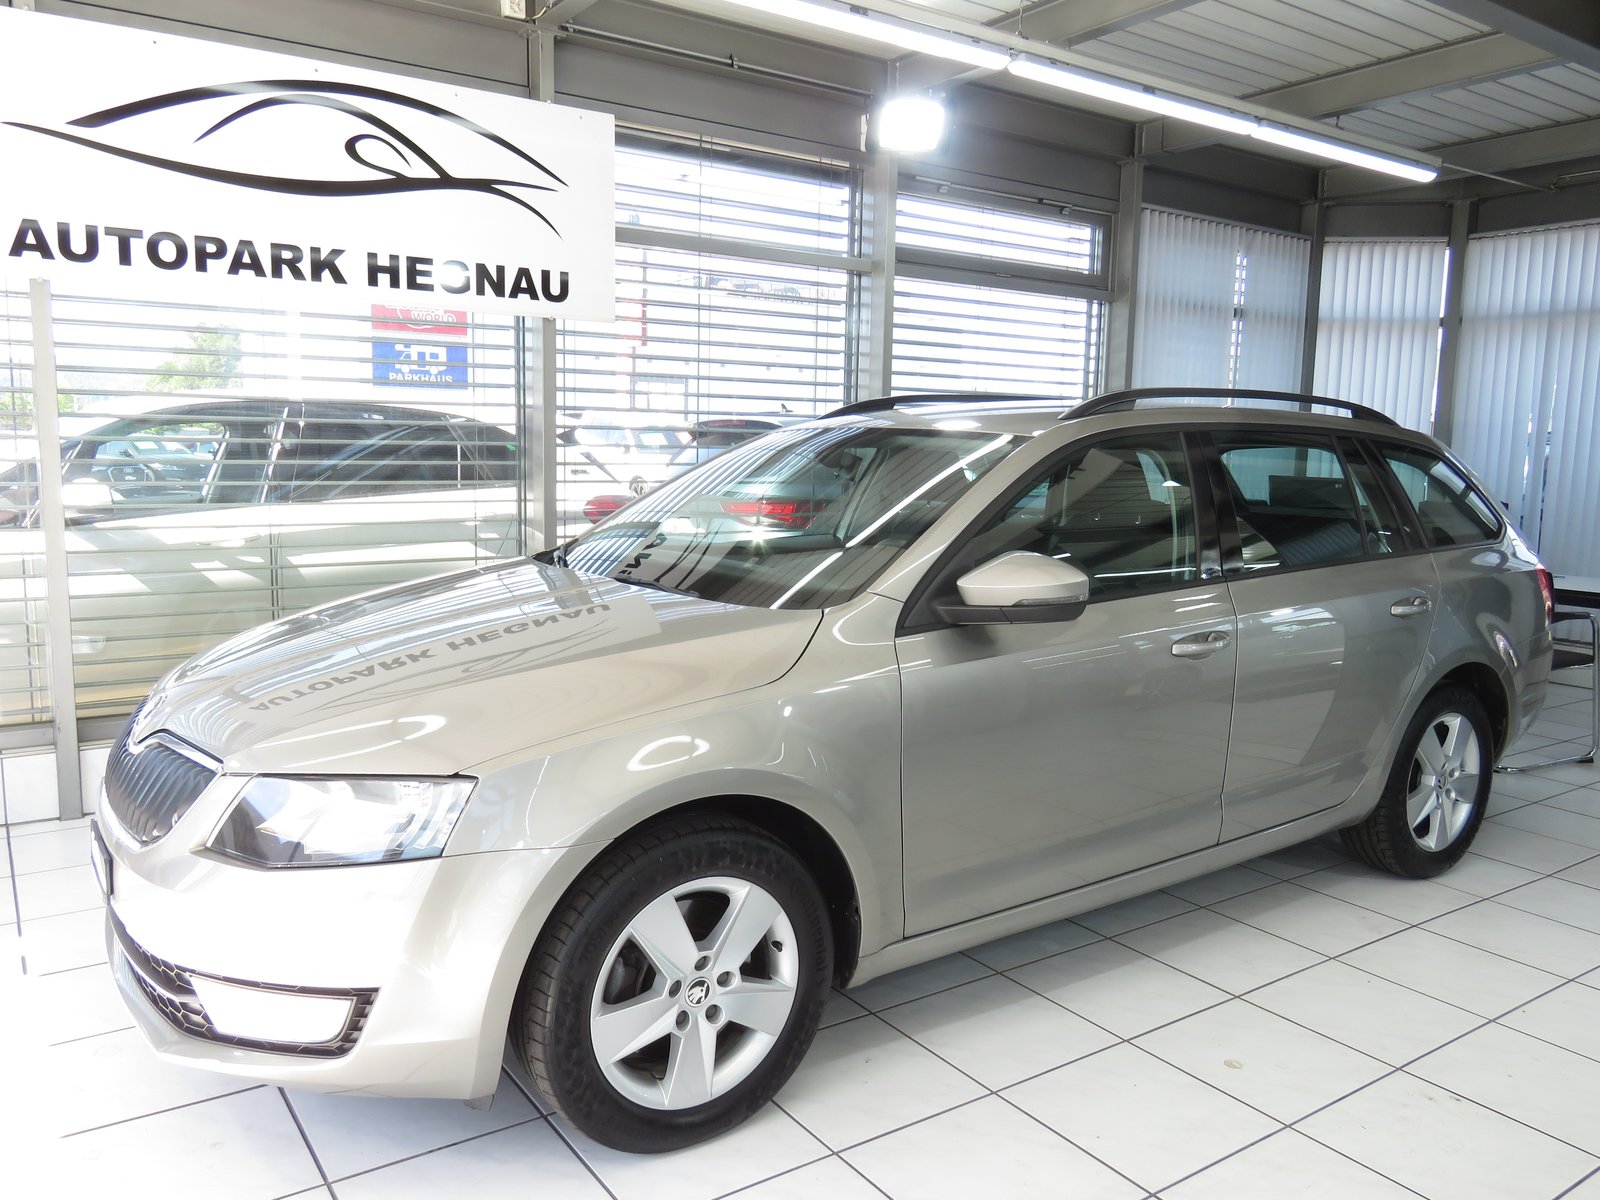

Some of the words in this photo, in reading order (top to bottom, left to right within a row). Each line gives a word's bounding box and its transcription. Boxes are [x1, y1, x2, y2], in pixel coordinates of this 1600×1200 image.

[8, 218, 347, 285] AUTOPARK
[412, 311, 456, 323] WORLD
[389, 372, 453, 383] PARKHAUS
